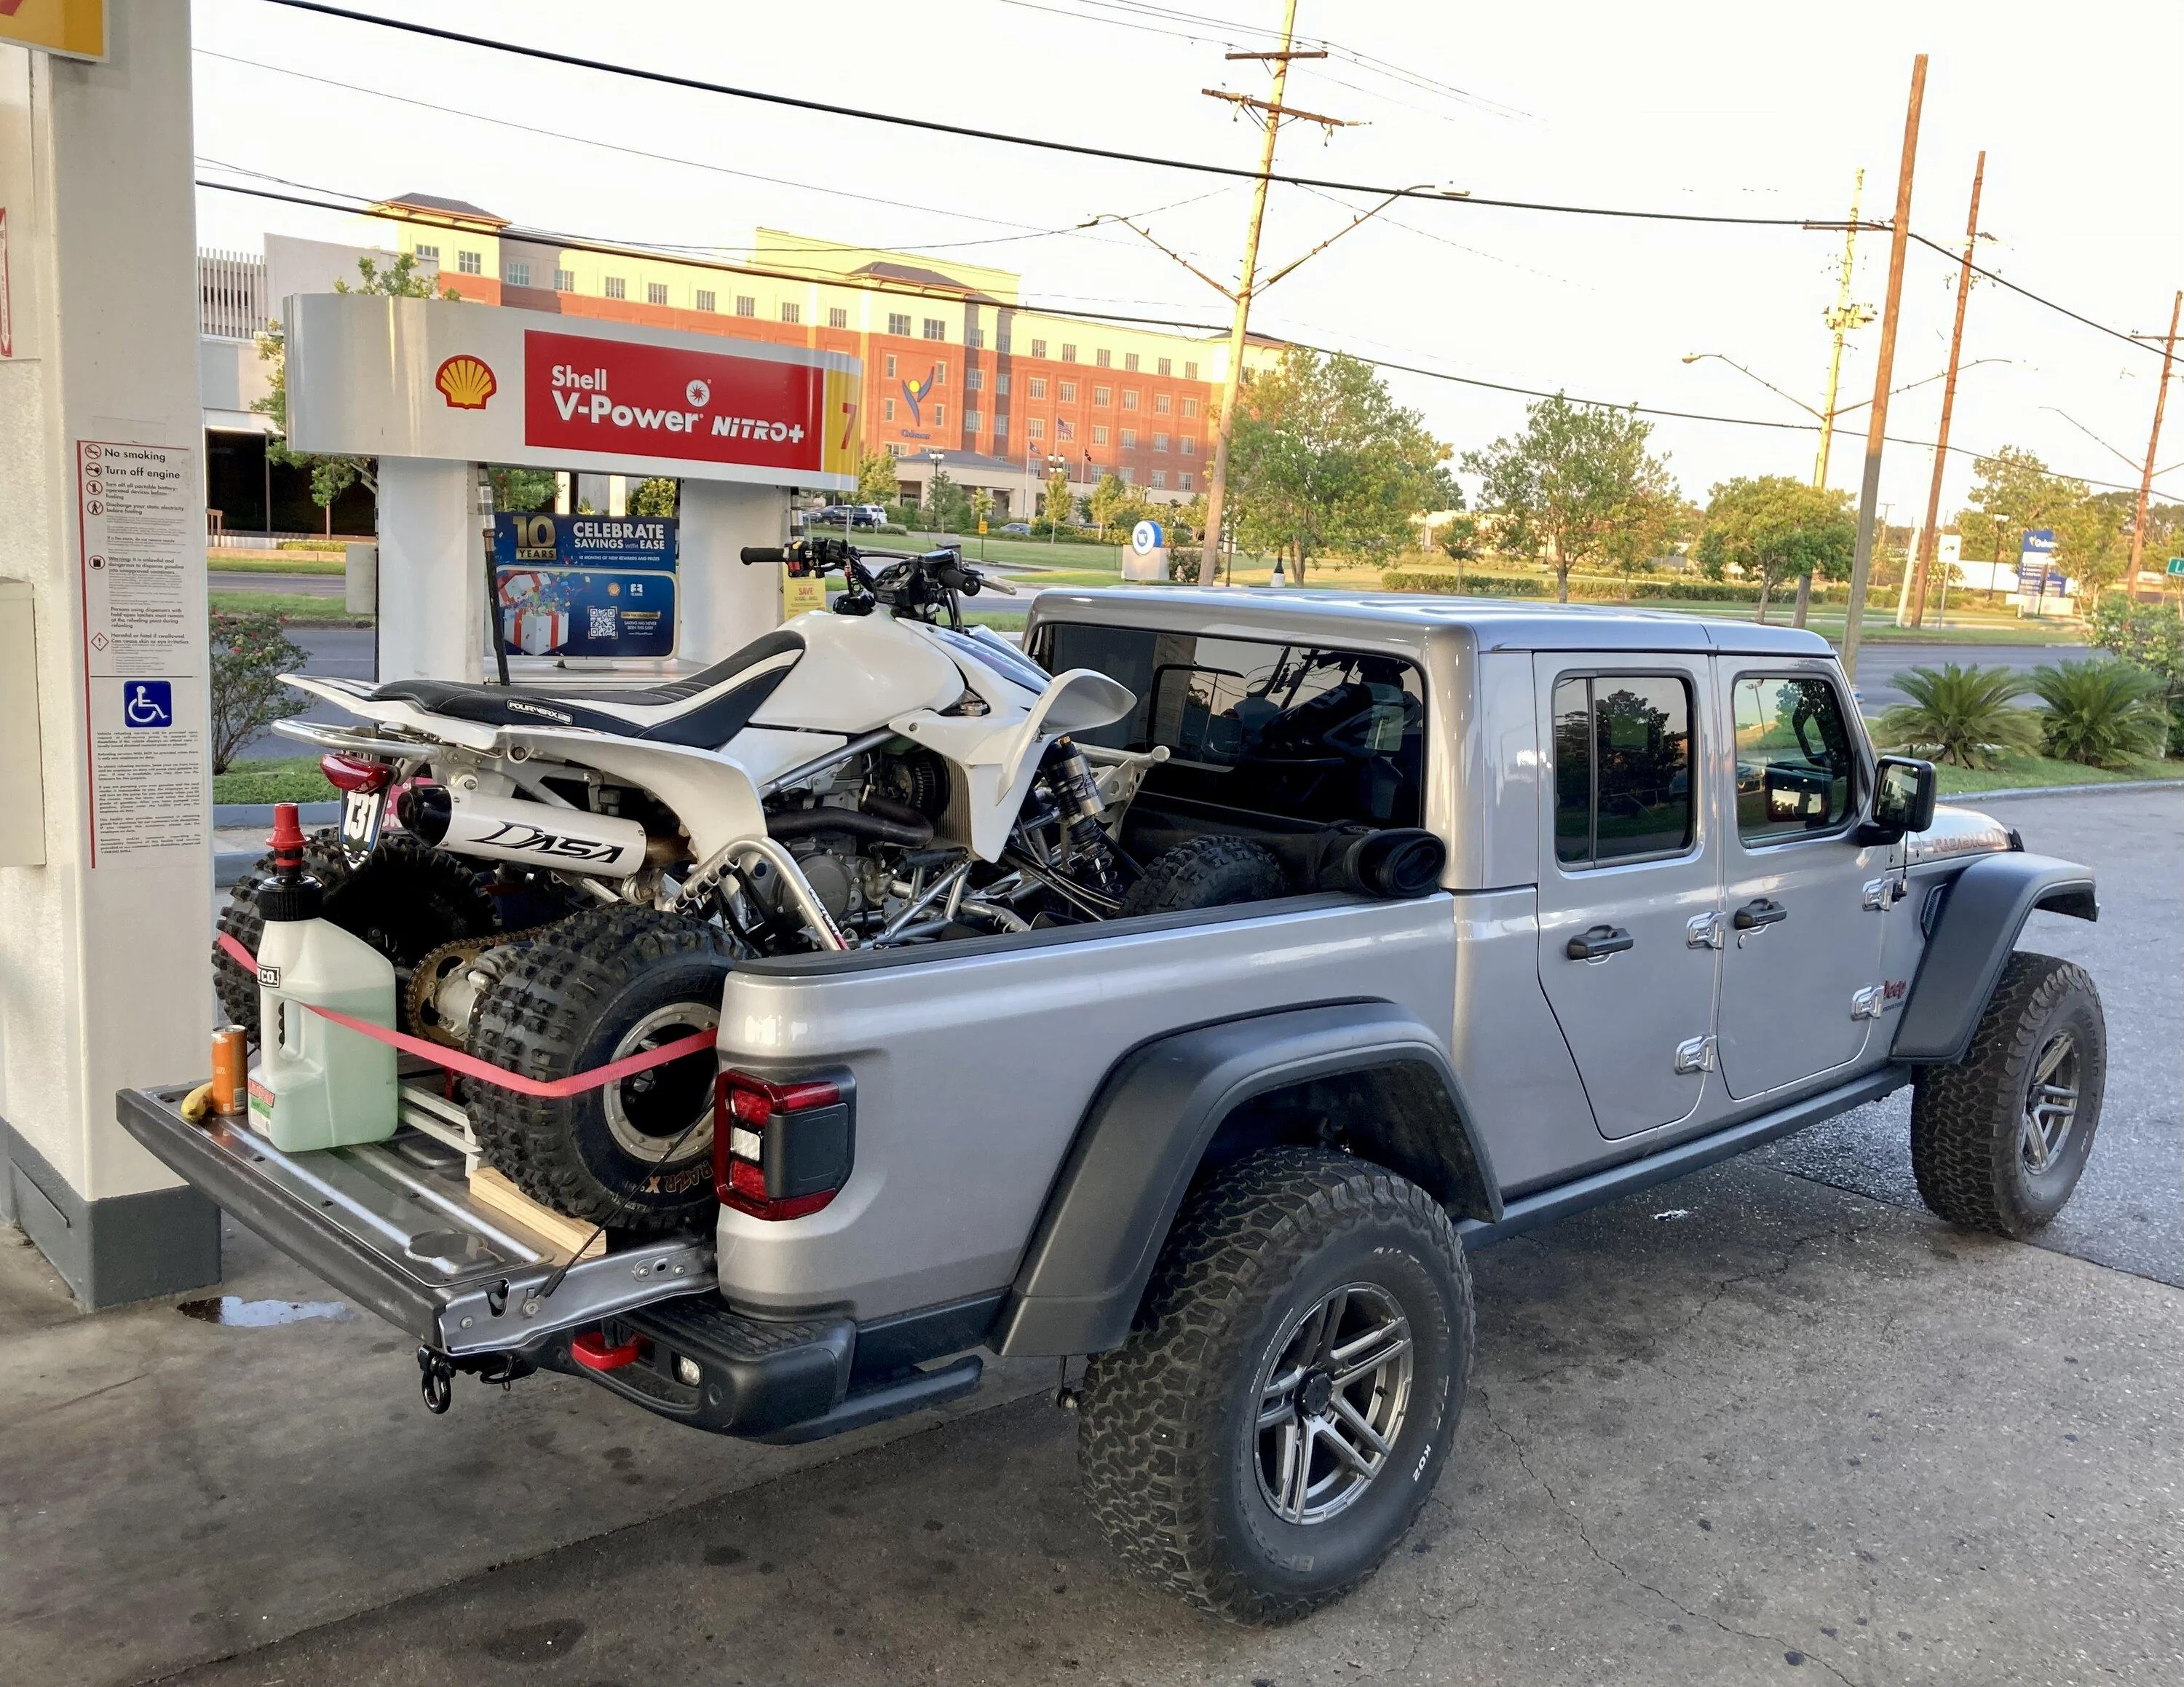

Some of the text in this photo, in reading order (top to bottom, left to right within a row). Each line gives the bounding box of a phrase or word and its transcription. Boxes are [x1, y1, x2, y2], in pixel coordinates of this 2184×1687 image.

[551, 365, 607, 391] Shell
[551, 390, 699, 433] V-Power
[840, 402, 858, 450] 7
[104, 448, 166, 462] No smoking
[105, 466, 181, 481] Turn off engine
[513, 515, 556, 548] 10
[573, 521, 665, 539] CELEBRATE
[574, 538, 623, 549] SAVINGS
[639, 540, 665, 550] EASE
[519, 550, 554, 558] YEARS
[799, 587, 813, 596] SAVE
[343, 790, 380, 843] 131
[464, 819, 625, 864] DASA
[644, 1159, 714, 1194] RAZR X
[1412, 1444, 1432, 1482] KO2
